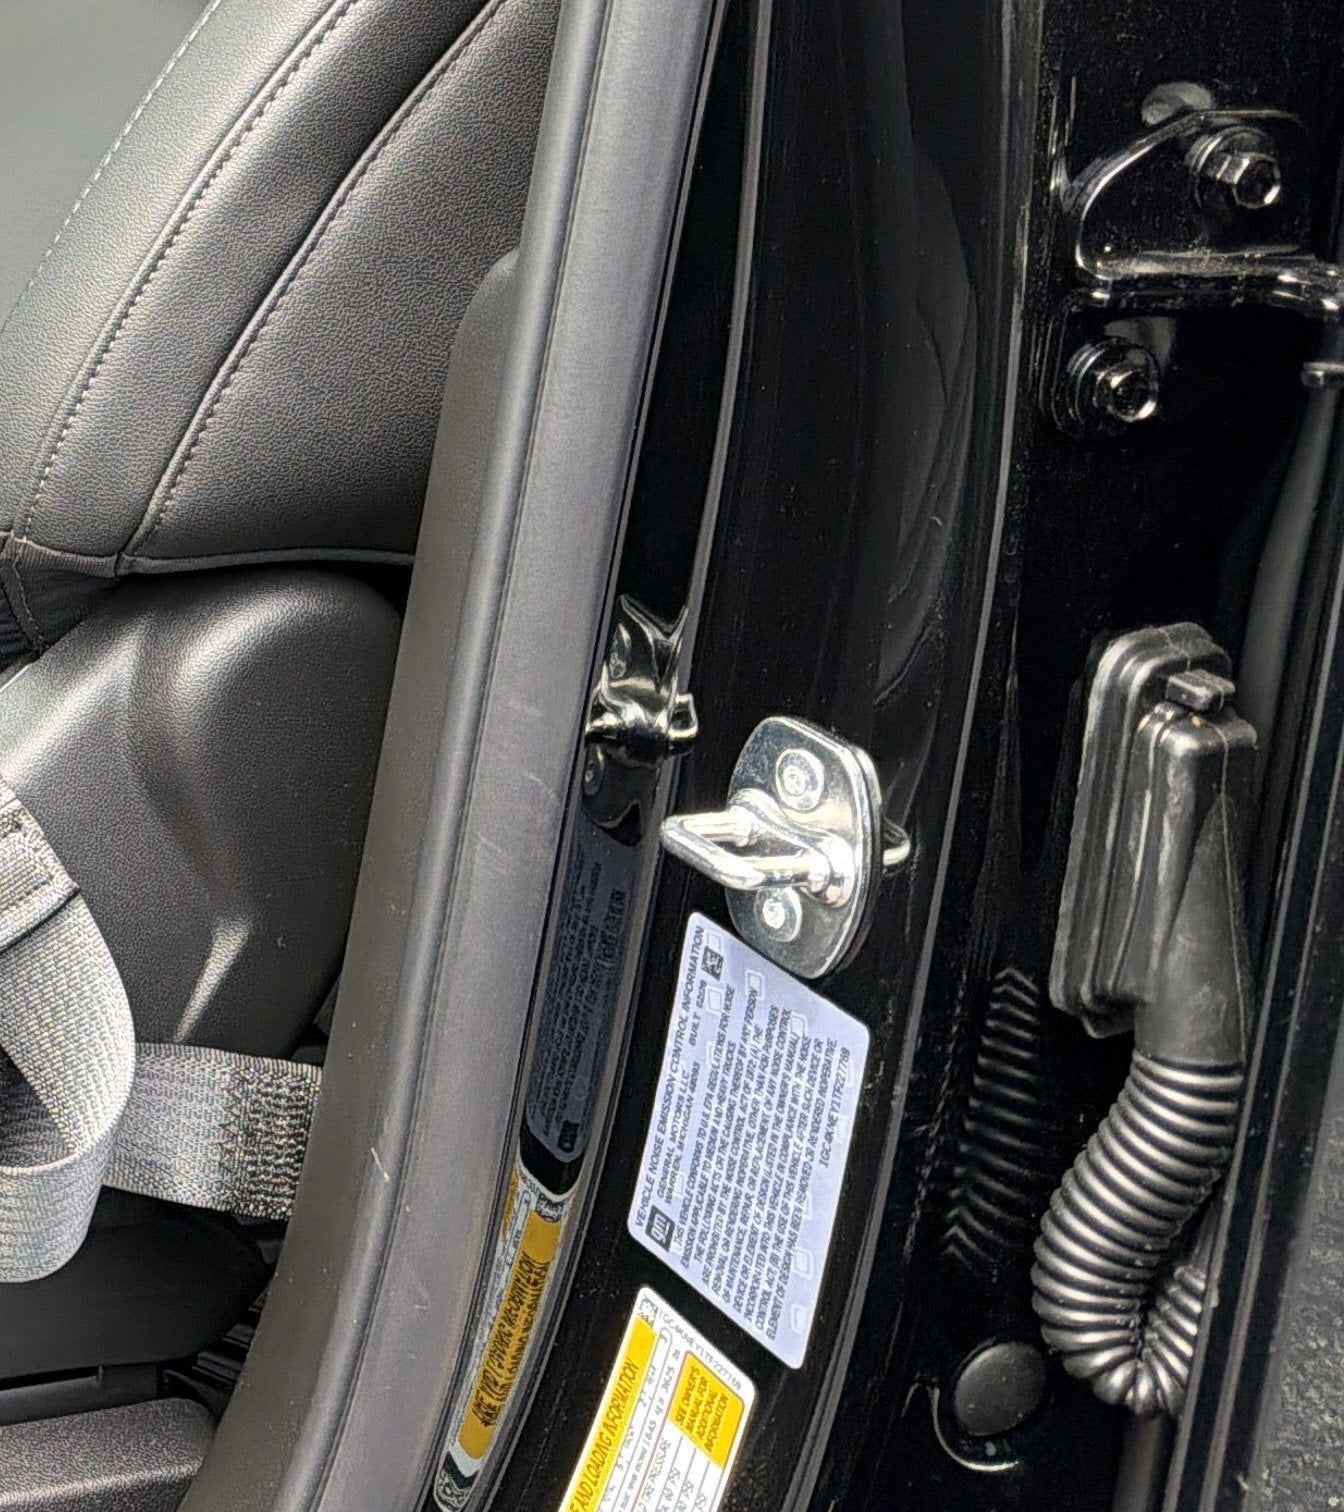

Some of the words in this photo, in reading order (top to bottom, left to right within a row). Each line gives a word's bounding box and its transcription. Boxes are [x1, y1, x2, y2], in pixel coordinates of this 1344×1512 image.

[723, 984, 734, 1012] NOISE
[744, 987, 757, 1025] PERSON
[688, 1011, 700, 1046] BUILT
[718, 1012, 729, 1032] FOR
[740, 1023, 750, 1044] ANY
[752, 1024, 763, 1043] THE
[762, 1005, 778, 1053] PURPOSES
[775, 1008, 791, 1049] CONTROL
[737, 1043, 746, 1058] BY
[798, 1032, 811, 1061] NOISE
[813, 1038, 823, 1053] OR
[707, 1031, 725, 1092] REGULATIONS
[758, 1053, 769, 1073] FOR
[770, 1049, 782, 1077] NOISE
[794, 1061, 805, 1079] THE
[806, 1052, 820, 1087] DEVICE
[635, 1174, 654, 1226] VEHICLE
[648, 1135, 663, 1174] NOISE
[657, 1074, 675, 1134] EMISSION
[669, 1015, 688, 1073] CONTROL
[681, 925, 703, 1011] INFORMATION
[729, 1056, 743, 1097] THEREOF
[742, 1080, 751, 1094] OF
[753, 1072, 765, 1095] THAN
[766, 1077, 776, 1097] ANY
[703, 1092, 713, 1111] EPA
[739, 1093, 748, 1114] ACT
[763, 1095, 772, 1111] OF
[790, 1081, 800, 1105] WITH
[801, 1086, 813, 1113] SUCH
[676, 1094, 693, 1151] MICHIGAN
[722, 1098, 736, 1137] CAUSING
[748, 1097, 760, 1128] OTHER
[771, 1113, 783, 1131] THE
[807, 1097, 824, 1146] RENDERED
[656, 1147, 674, 1197] GENERAL
[669, 1094, 684, 1142] MOTORS
[678, 1068, 689, 1093] LLC
[696, 1127, 706, 1140] TO
[730, 1115, 745, 1155] CONTROL
[778, 1104, 797, 1162] COMPLIANCE
[796, 1112, 808, 1142] AFTER
[717, 1137, 728, 1154] THE
[680, 1226, 696, 1268] EMISSION
[701, 1159, 711, 1173] TO
[712, 1106, 722, 1126] AND
[717, 1076, 727, 1106] HEAVY
[686, 1140, 703, 1189] CONFORMS
[715, 1154, 724, 1170] OR
[725, 1155, 736, 1182] NOISE
[788, 1141, 802, 1180] VEHICLE
[710, 1170, 721, 1194] ACTS
[720, 1182, 731, 1200] THE
[747, 1175, 756, 1191] OR
[756, 1176, 769, 1211] DESIGN
[768, 1172, 783, 1210] VEHICLE
[782, 1179, 794, 1200] THIS
[795, 1161, 812, 1204] REMOVED
[679, 1188, 693, 1225] VEHICLE
[698, 1193, 716, 1245] FOLLOWING
[717, 1200, 726, 1215] BY
[752, 1210, 761, 1225] OF
[763, 1210, 775, 1230] THIS
[780, 1199, 789, 1215] OF
[790, 1206, 802, 1231] BEEN
[651, 1213, 669, 1242] gm
[776, 1214, 787, 1234] USE
[693, 1244, 704, 1262] THE
[721, 1237, 730, 1252] OR
[743, 1223, 758, 1265] ELEMENT
[759, 1231, 770, 1254] INTO
[772, 1233, 783, 1251] THE
[786, 1230, 797, 1250] HAS
[701, 1264, 711, 1286] ARE
[740, 1264, 750, 1280] OR
[778, 1249, 792, 1285] DESIGN
[722, 1288, 730, 1303] OF
[732, 1278, 747, 1312] DEVICE
[775, 1282, 785, 1298] OF
[755, 1289, 771, 1329] CONTROL
[766, 1296, 781, 1340] ELEMENT
[602, 1357, 638, 1436] INFORMATION
[675, 1405, 686, 1425] SEE
[685, 1398, 702, 1433] MANUAL
[696, 1390, 717, 1440] ADDITIONAL
[704, 1393, 728, 1452] INFORMATION
[583, 1431, 611, 1486] LOADING
[574, 1481, 593, 1512] AND
